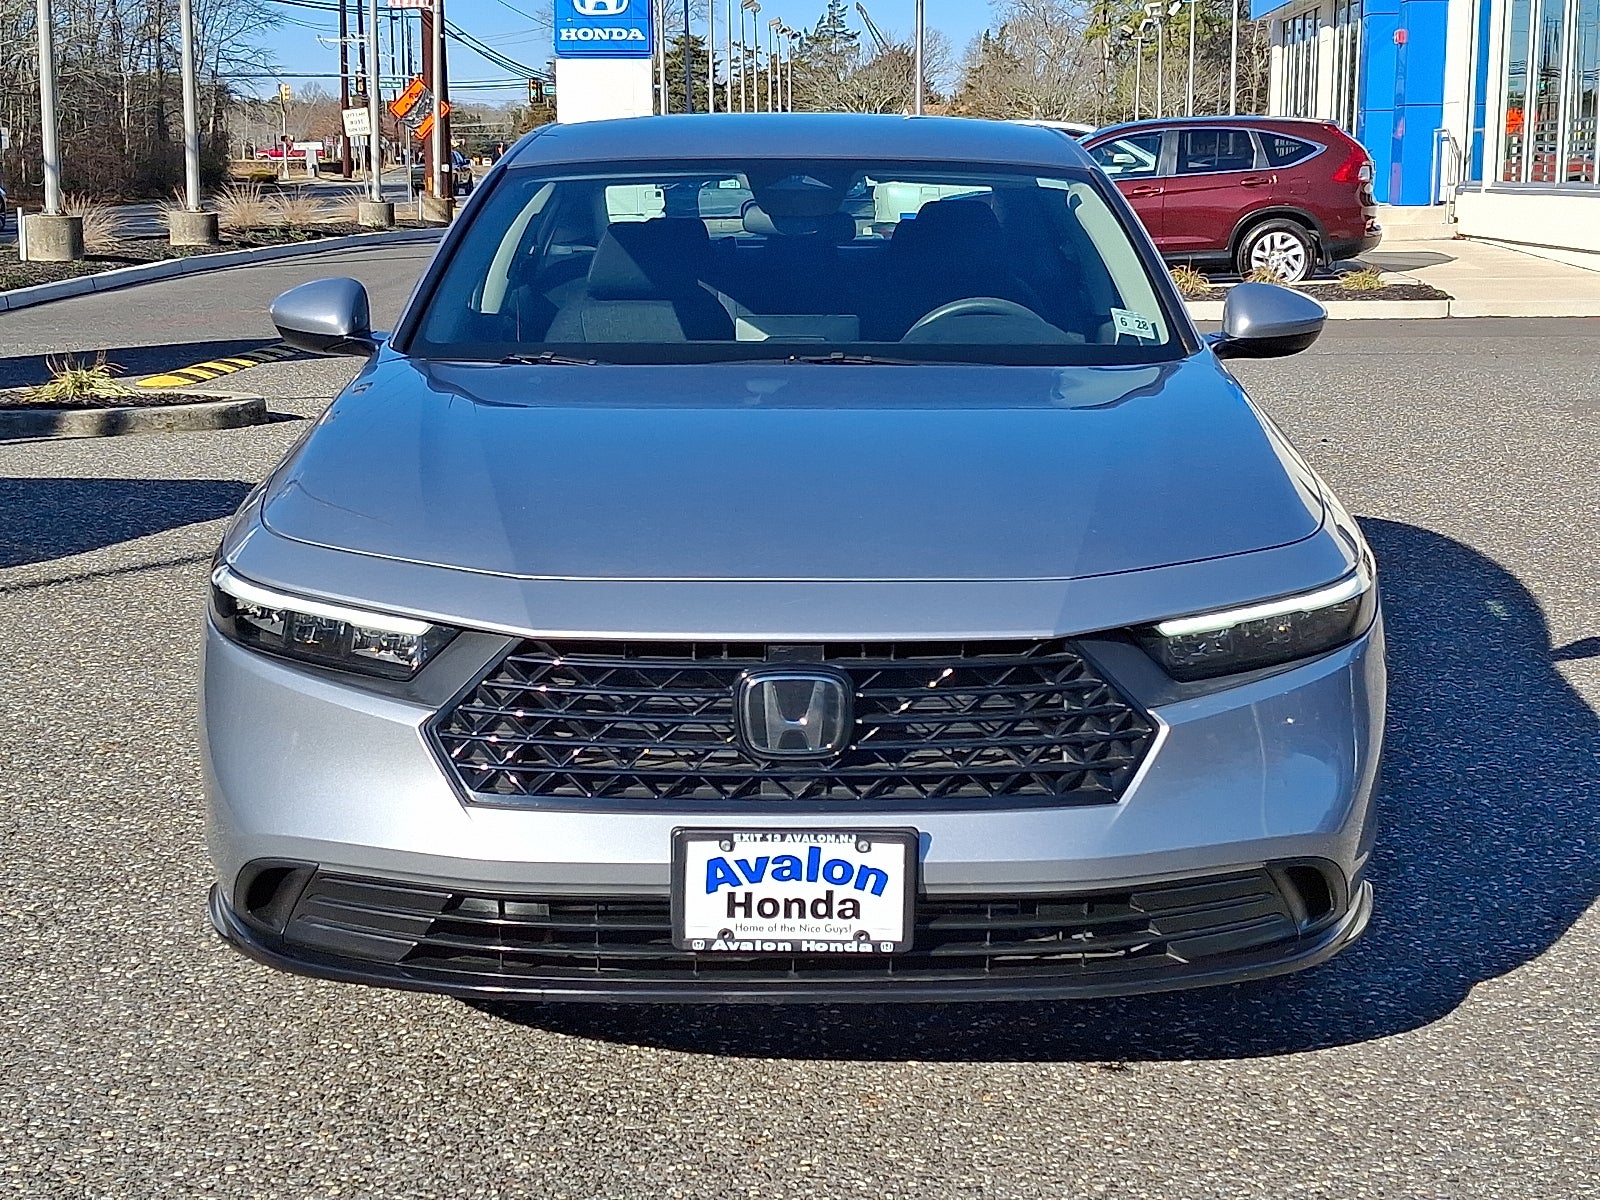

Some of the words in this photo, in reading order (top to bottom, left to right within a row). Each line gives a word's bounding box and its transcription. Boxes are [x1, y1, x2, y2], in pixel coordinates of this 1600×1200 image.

[559, 28, 646, 41] HONDA
[1120, 317, 1128, 326] 6
[1135, 319, 1149, 330] 28
[733, 833, 762, 842] EXIT
[705, 846, 889, 897] Avalon
[726, 890, 861, 920] Honda
[735, 923, 764, 932] Home
[768, 923, 777, 932] of
[780, 923, 796, 932] the
[799, 924, 820, 933] Nice
[825, 924, 852, 935] Guys!
[711, 939, 792, 952] Avalon
[801, 939, 874, 952] Honda
